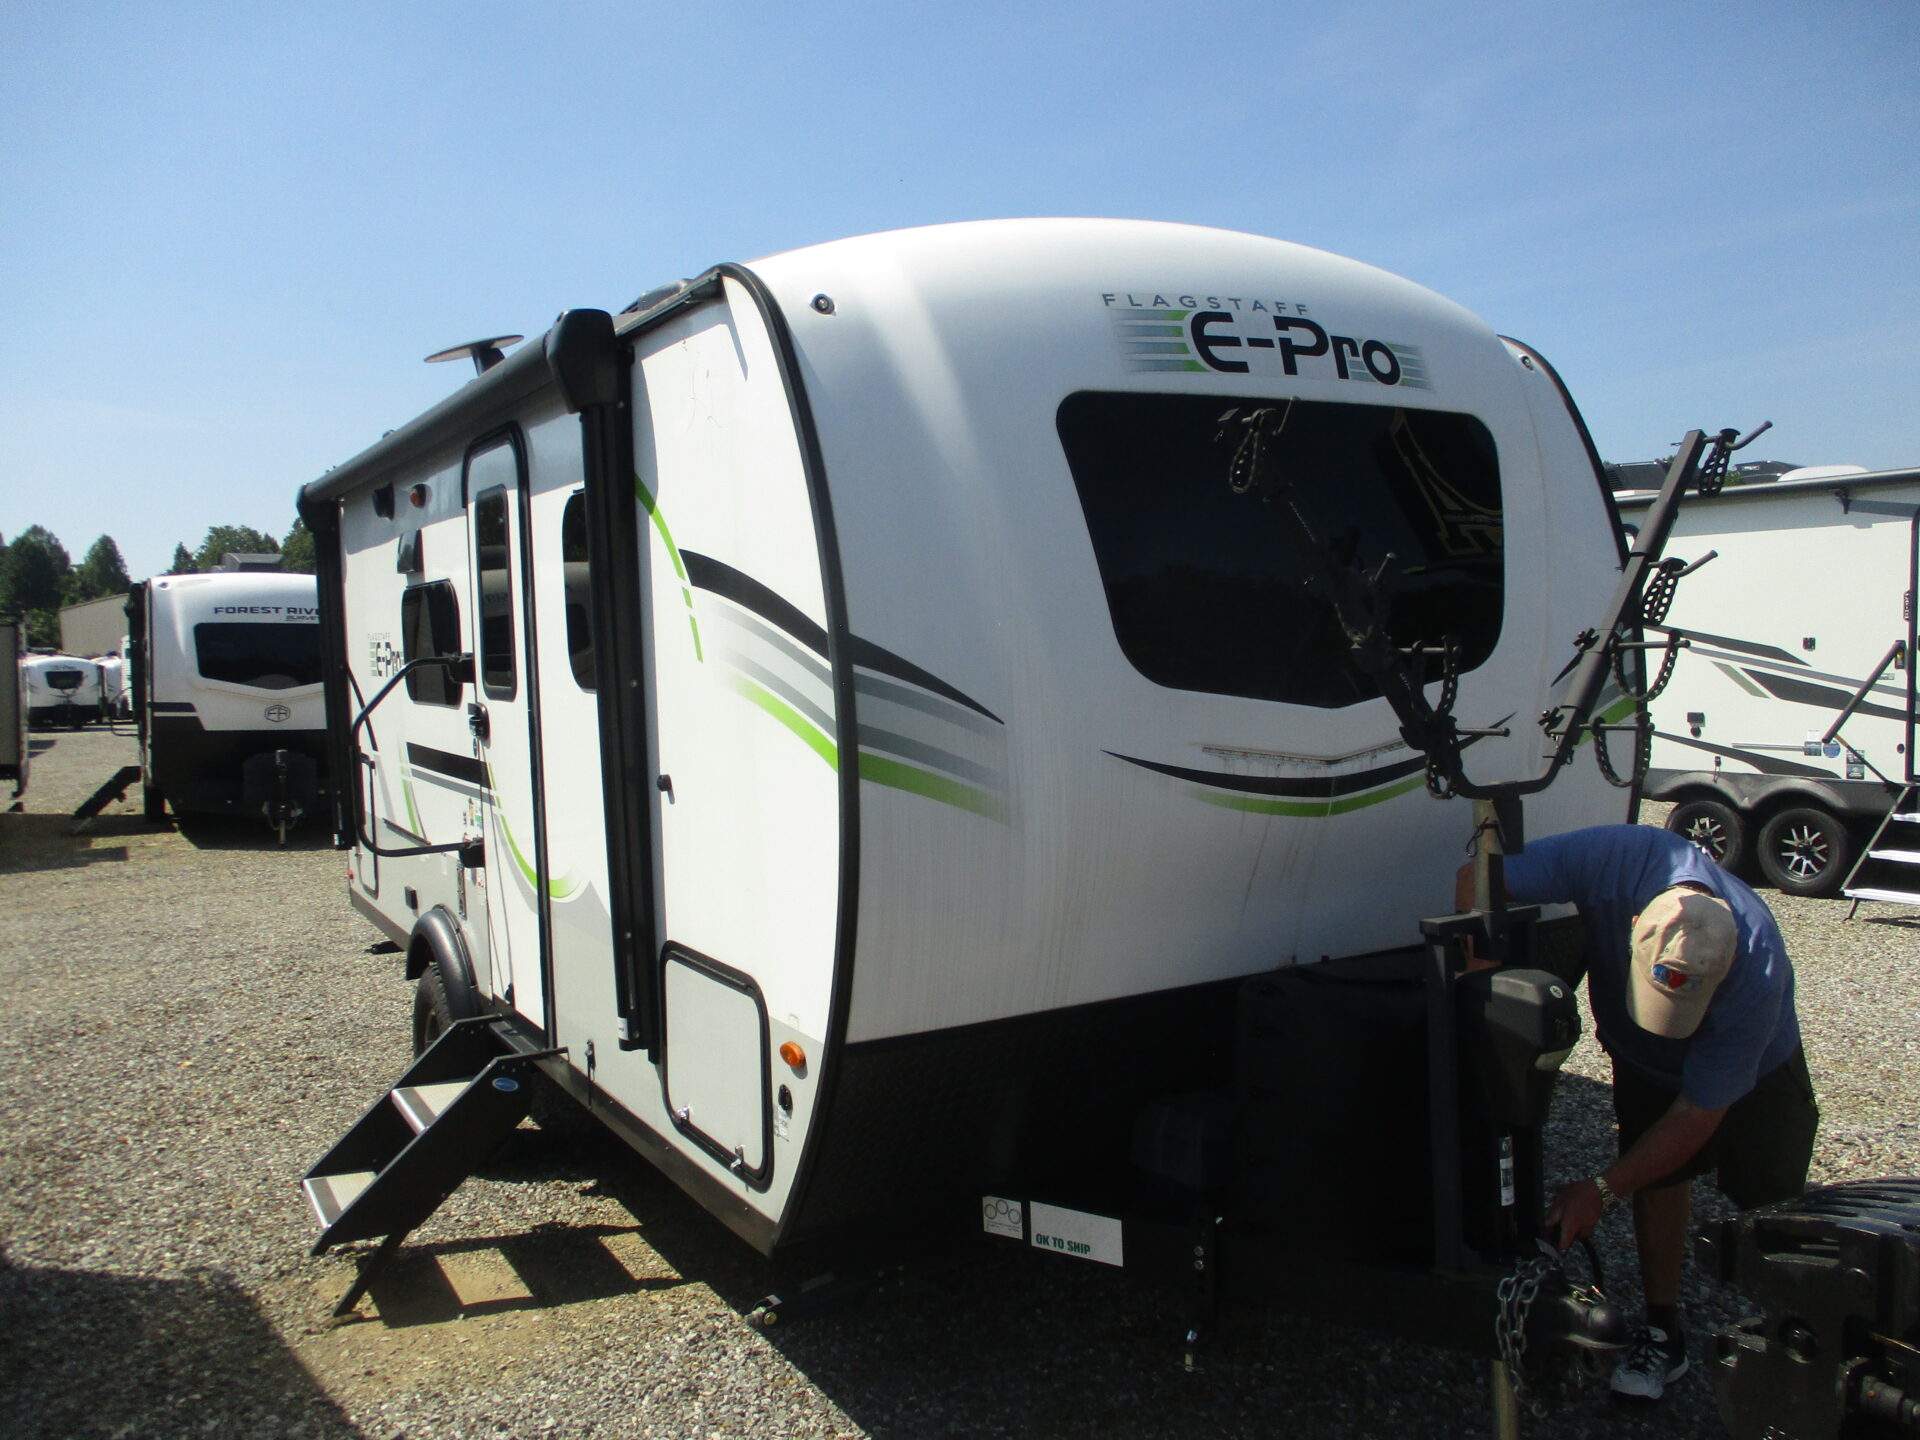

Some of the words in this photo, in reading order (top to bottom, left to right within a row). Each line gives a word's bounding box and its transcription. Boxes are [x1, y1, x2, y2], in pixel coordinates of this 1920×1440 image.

[1101, 293, 1309, 316] FLAGSTAFF
[1190, 310, 1402, 386] E-Pro
[213, 606, 283, 615] FOREST
[1035, 1232, 1050, 1247] OK
[1051, 1236, 1065, 1250] TO
[1066, 1240, 1091, 1255] SHIP
